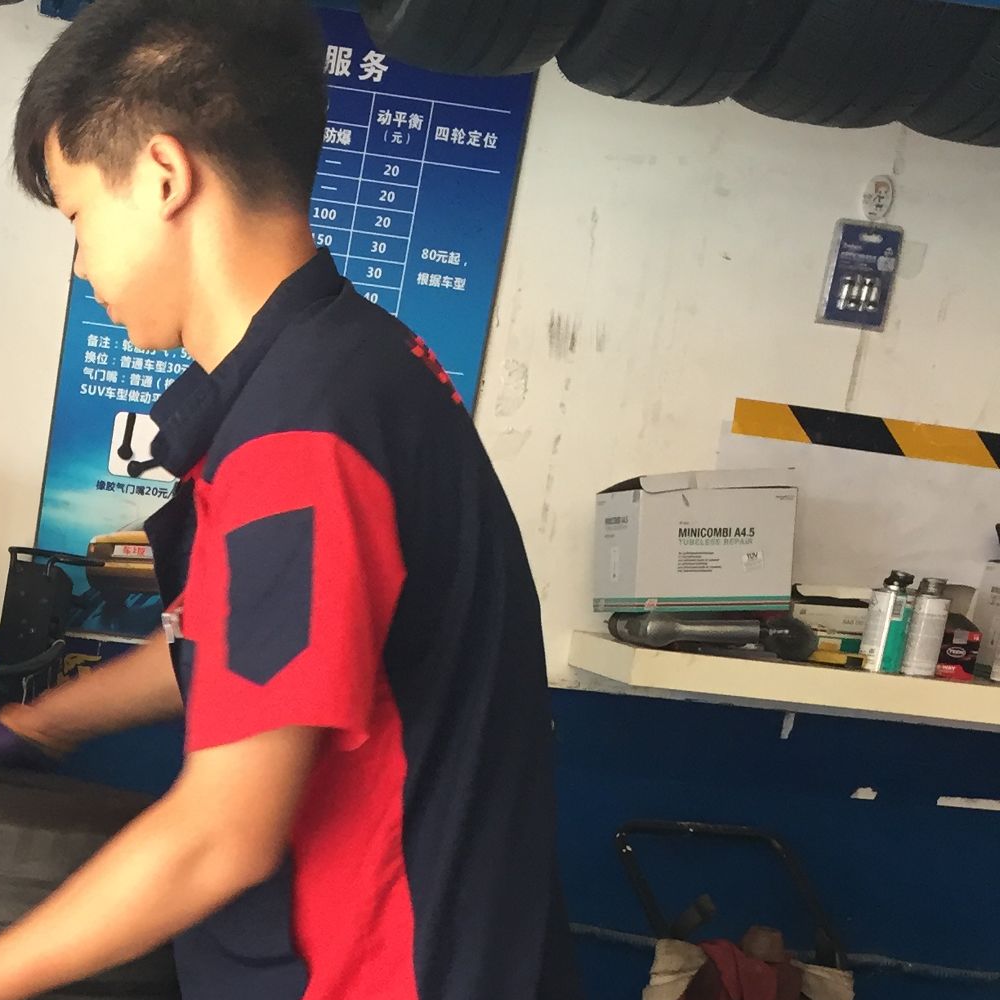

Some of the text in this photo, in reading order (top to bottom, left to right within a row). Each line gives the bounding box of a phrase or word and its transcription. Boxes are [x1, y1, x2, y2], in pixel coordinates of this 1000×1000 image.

[324, 44, 389, 82] 服务
[376, 109, 424, 131] 动平衡
[434, 126, 499, 149] 四轮定位
[383, 164, 400, 177] 20
[379, 190, 396, 202] 20
[312, 207, 337, 220] 100
[374, 216, 391, 228] 20
[370, 241, 387, 253] 30
[366, 266, 382, 279] 30
[416, 272, 466, 291] 根据车型
[678, 527, 732, 538] MINICOMBI
